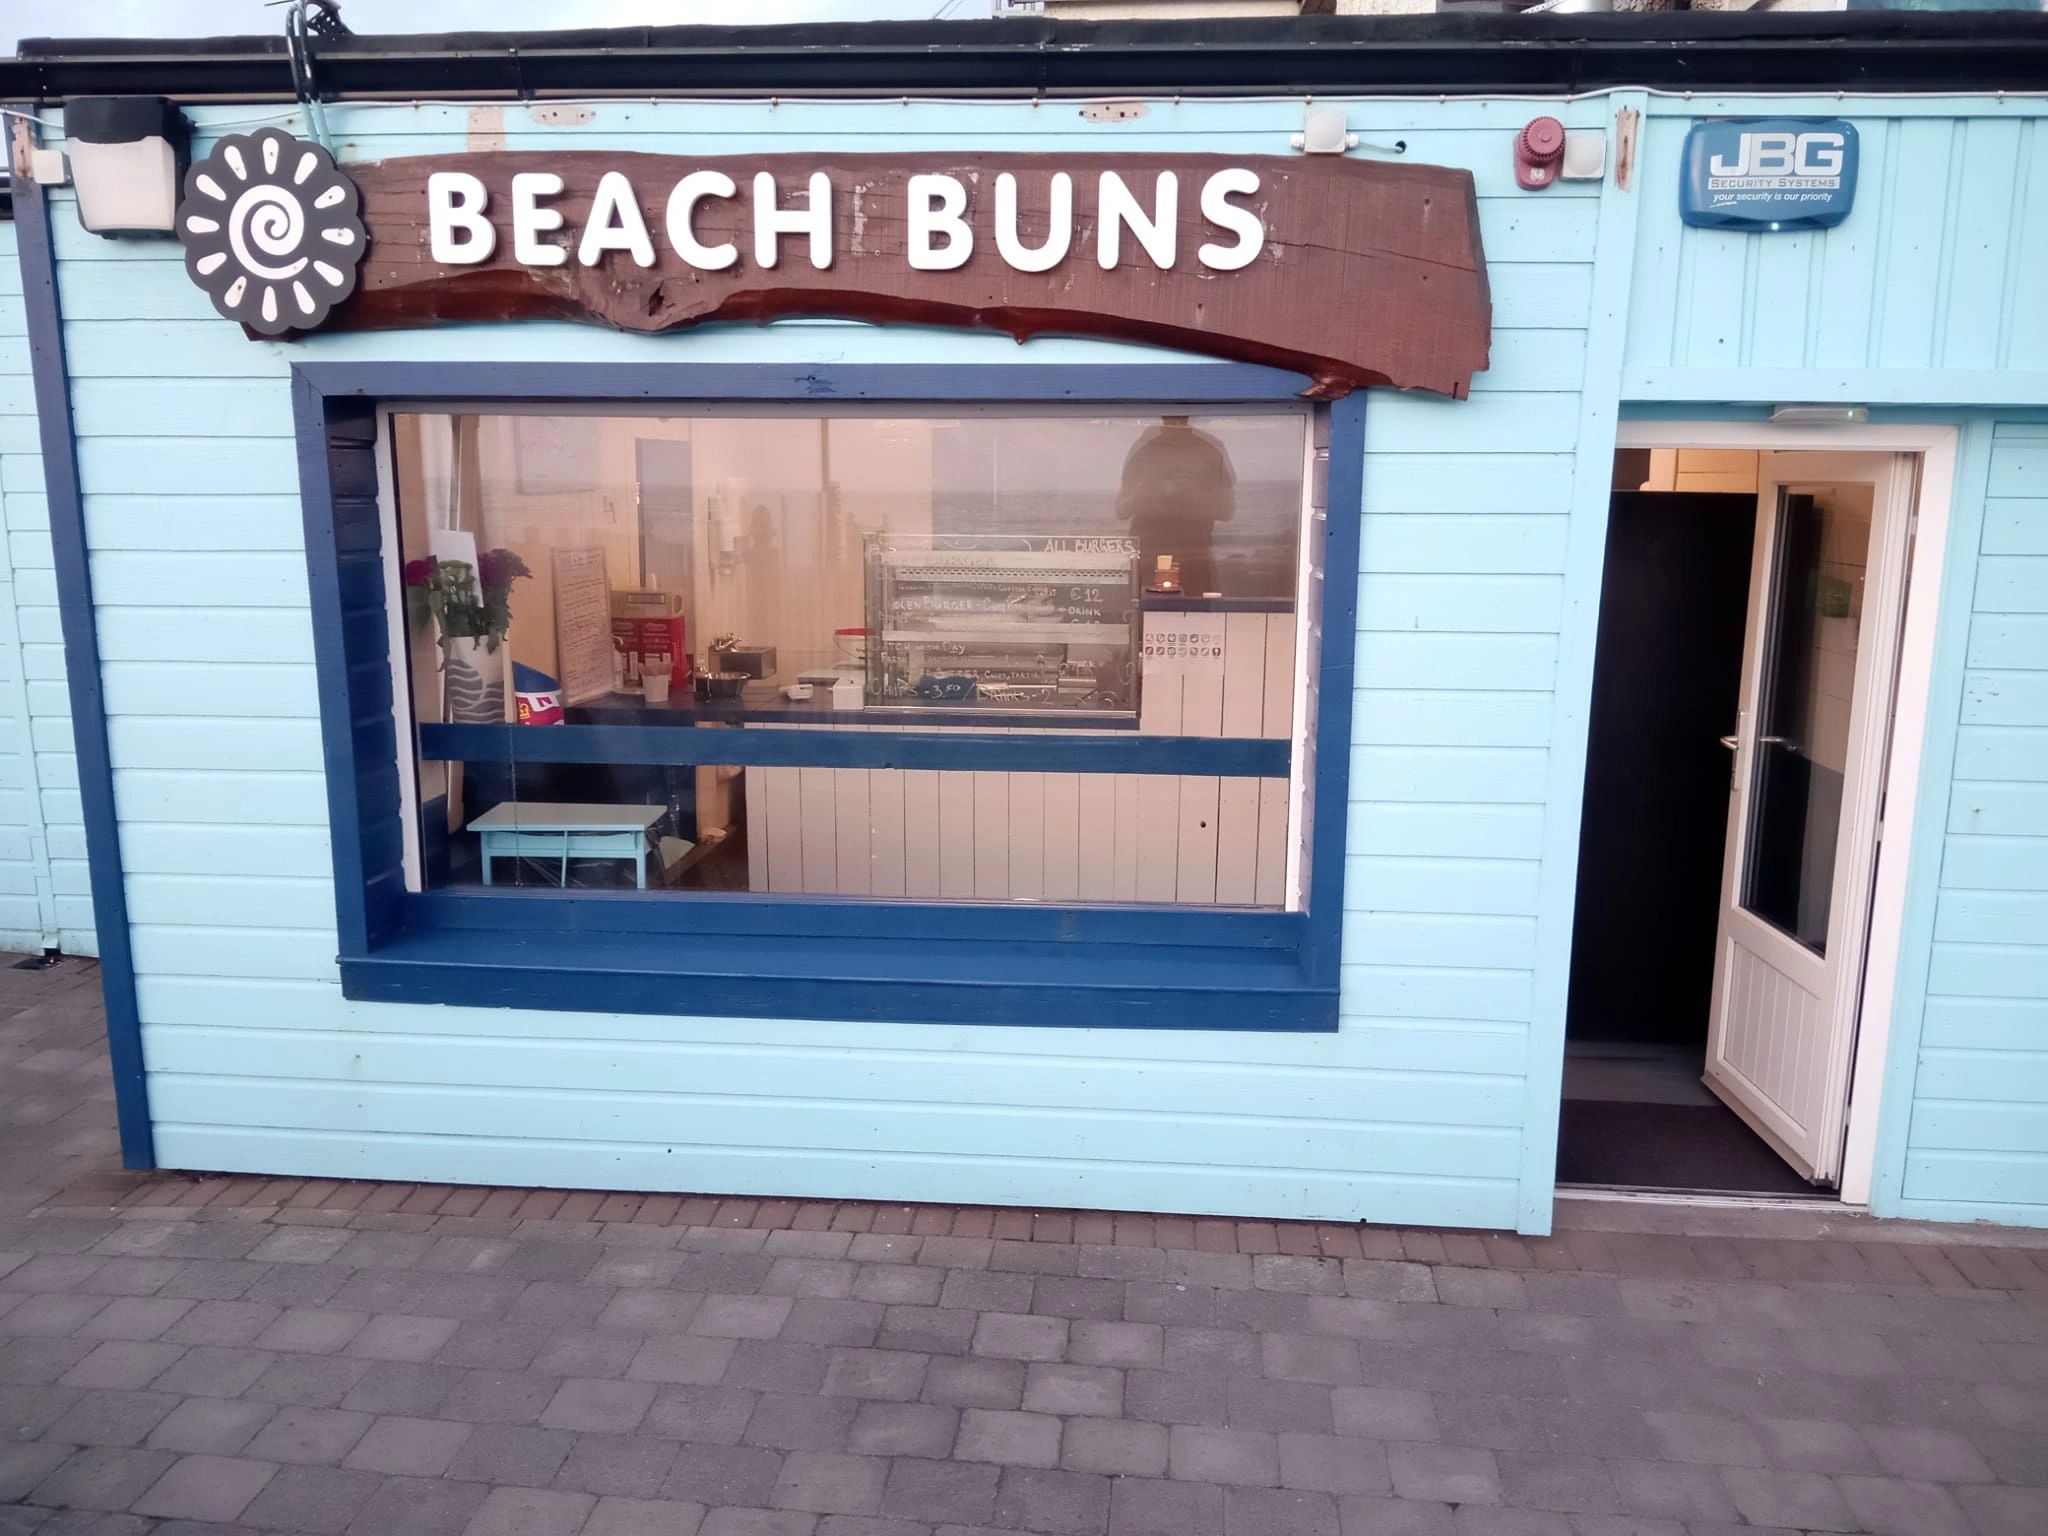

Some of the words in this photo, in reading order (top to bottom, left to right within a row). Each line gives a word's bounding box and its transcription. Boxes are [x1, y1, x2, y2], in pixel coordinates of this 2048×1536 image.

[1710, 133, 1845, 176] JBG
[1713, 193, 1735, 203] your
[1736, 192, 1774, 201] security
[1774, 191, 1782, 201] is
[1783, 193, 1800, 201] our
[1800, 192, 1833, 203] priority
[428, 170, 833, 272] BEACH
[907, 168, 1266, 273] BUNS
[1075, 538, 1135, 554] BURGERS
[1068, 606, 1102, 617] DRINK
